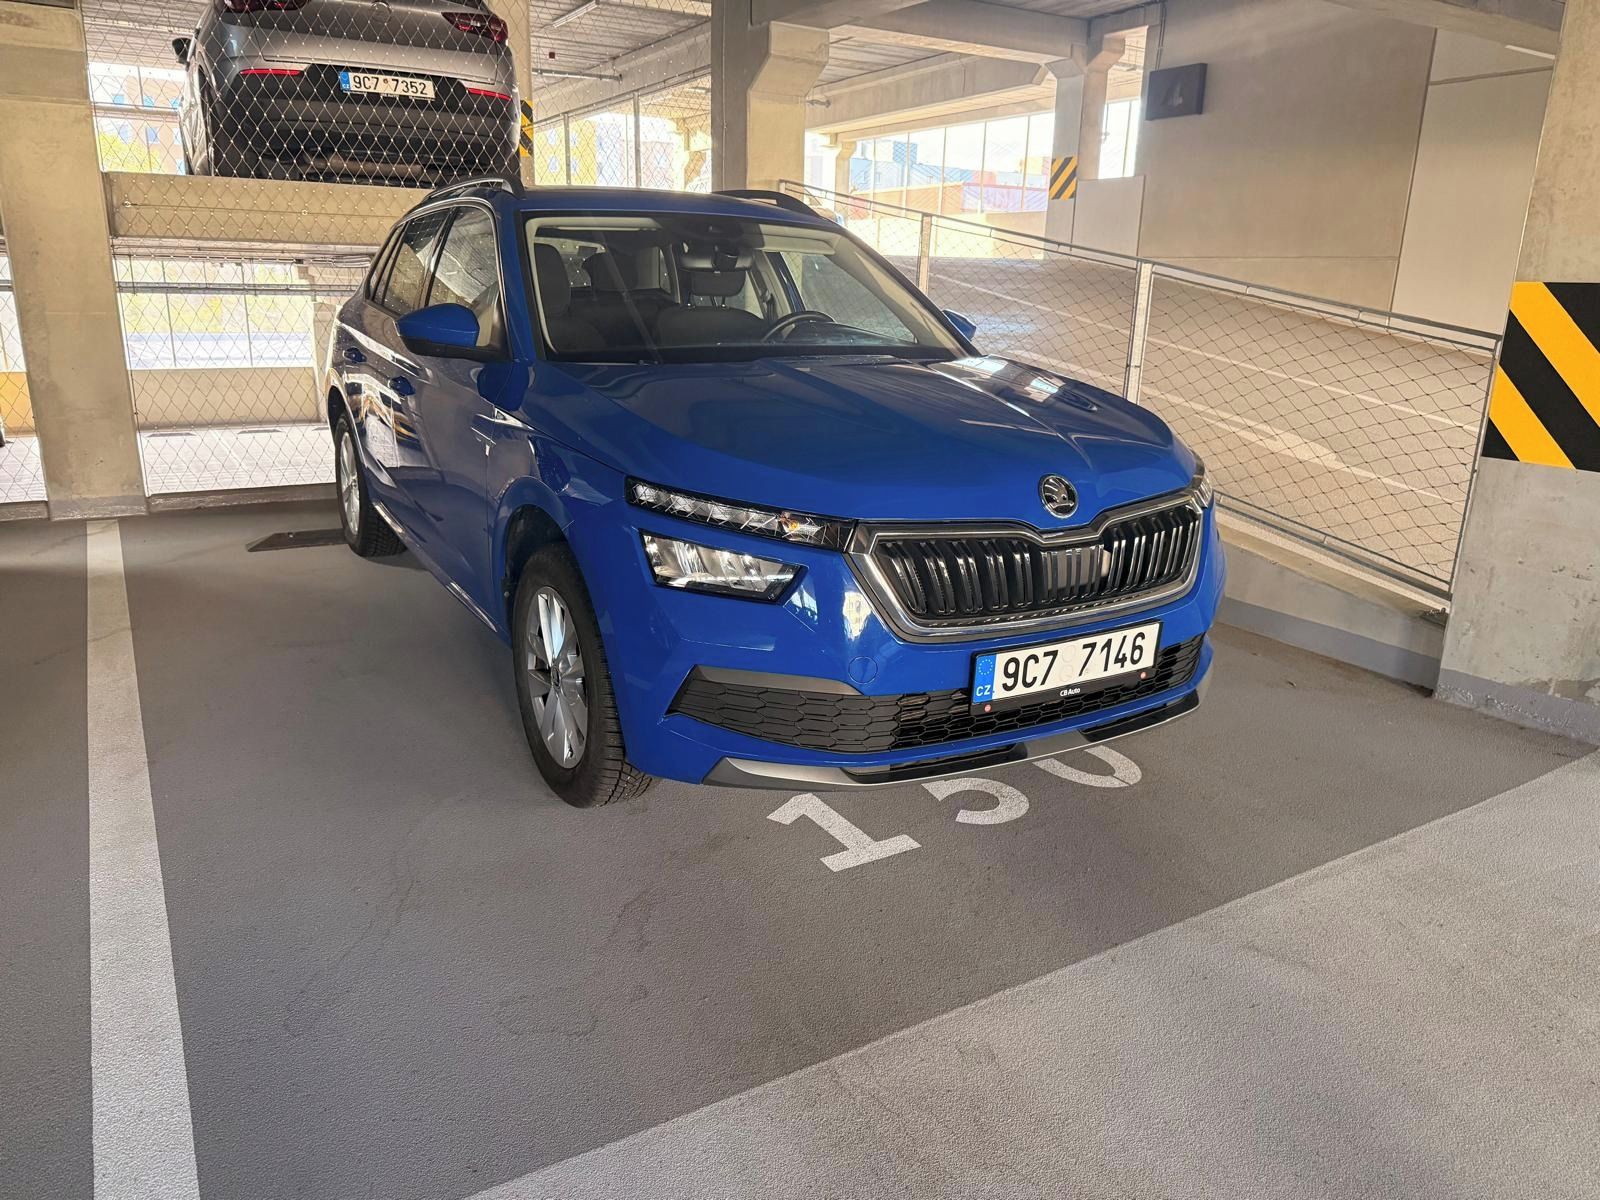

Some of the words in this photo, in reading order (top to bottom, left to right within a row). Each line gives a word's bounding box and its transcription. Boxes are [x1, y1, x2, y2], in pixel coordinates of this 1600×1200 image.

[353, 76, 379, 90] 9C7
[391, 78, 428, 95] 7352
[1002, 650, 1059, 692] 9C7
[1078, 631, 1146, 677] 7146
[976, 685, 991, 697] CZ
[1068, 688, 1081, 696] Auto
